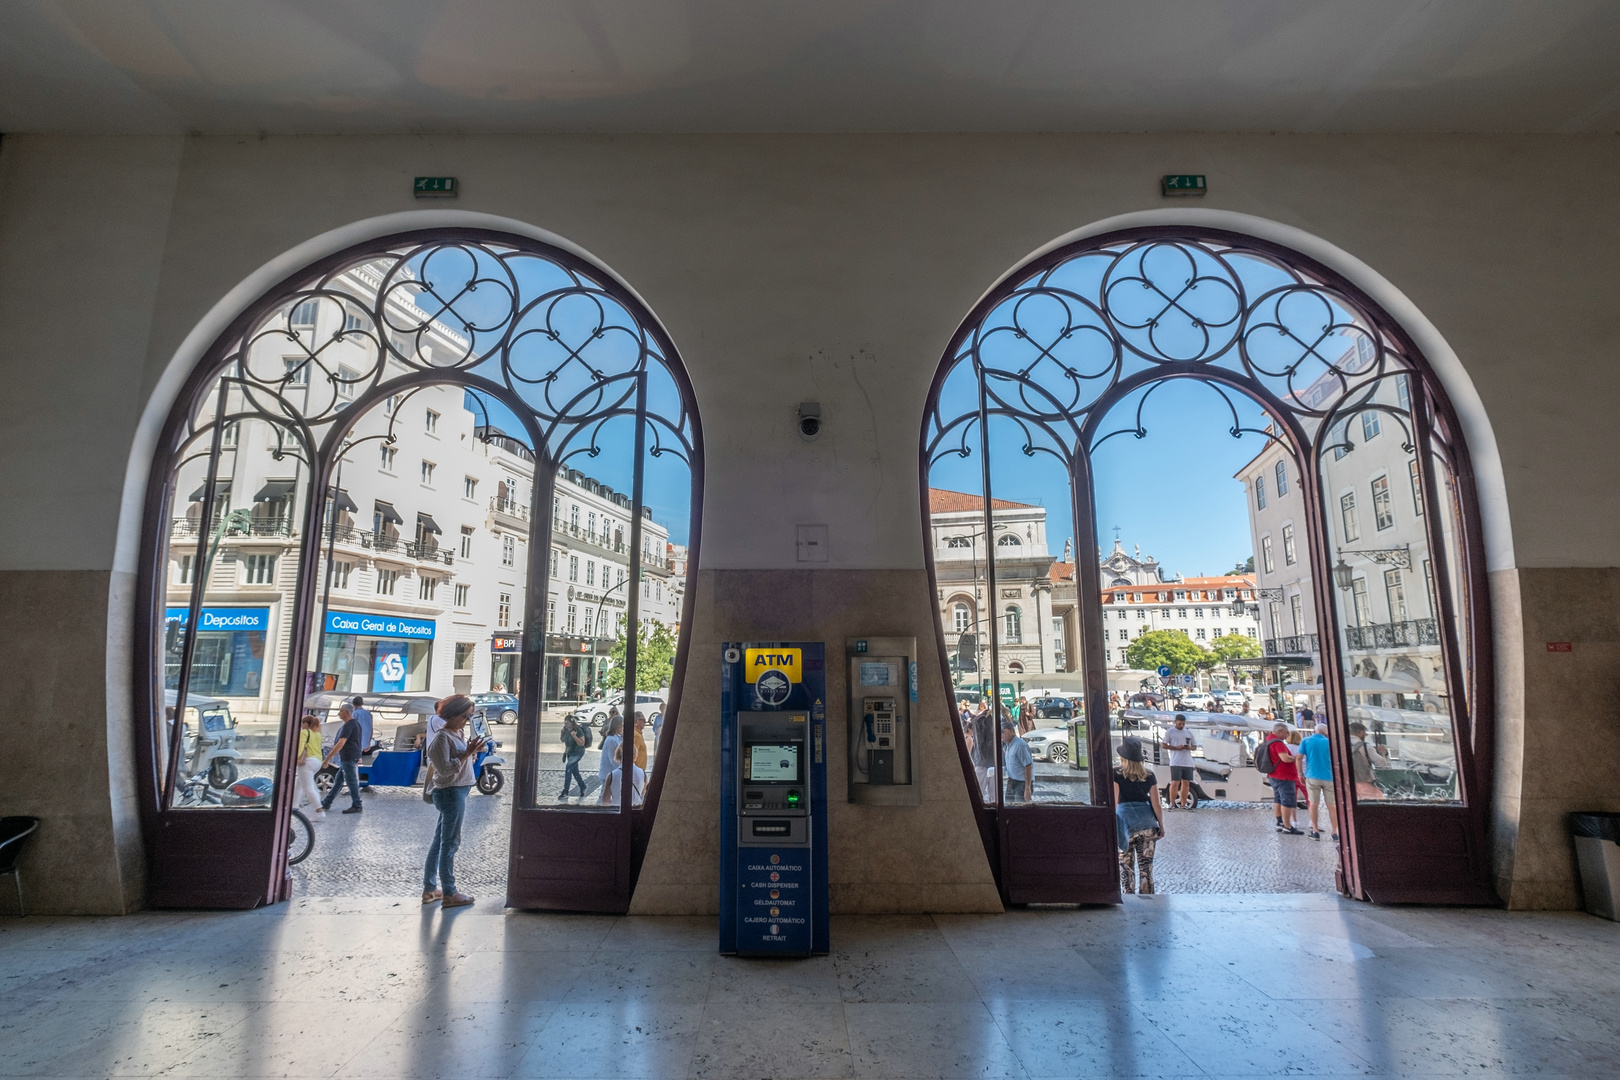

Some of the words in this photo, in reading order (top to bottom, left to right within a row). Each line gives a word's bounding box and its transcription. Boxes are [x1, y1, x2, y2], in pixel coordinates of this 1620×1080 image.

[331, 616, 359, 629] Caixa
[361, 619, 385, 632] Geral
[386, 622, 397, 632] de
[503, 639, 516, 648] BPI
[754, 654, 793, 666] ATM
